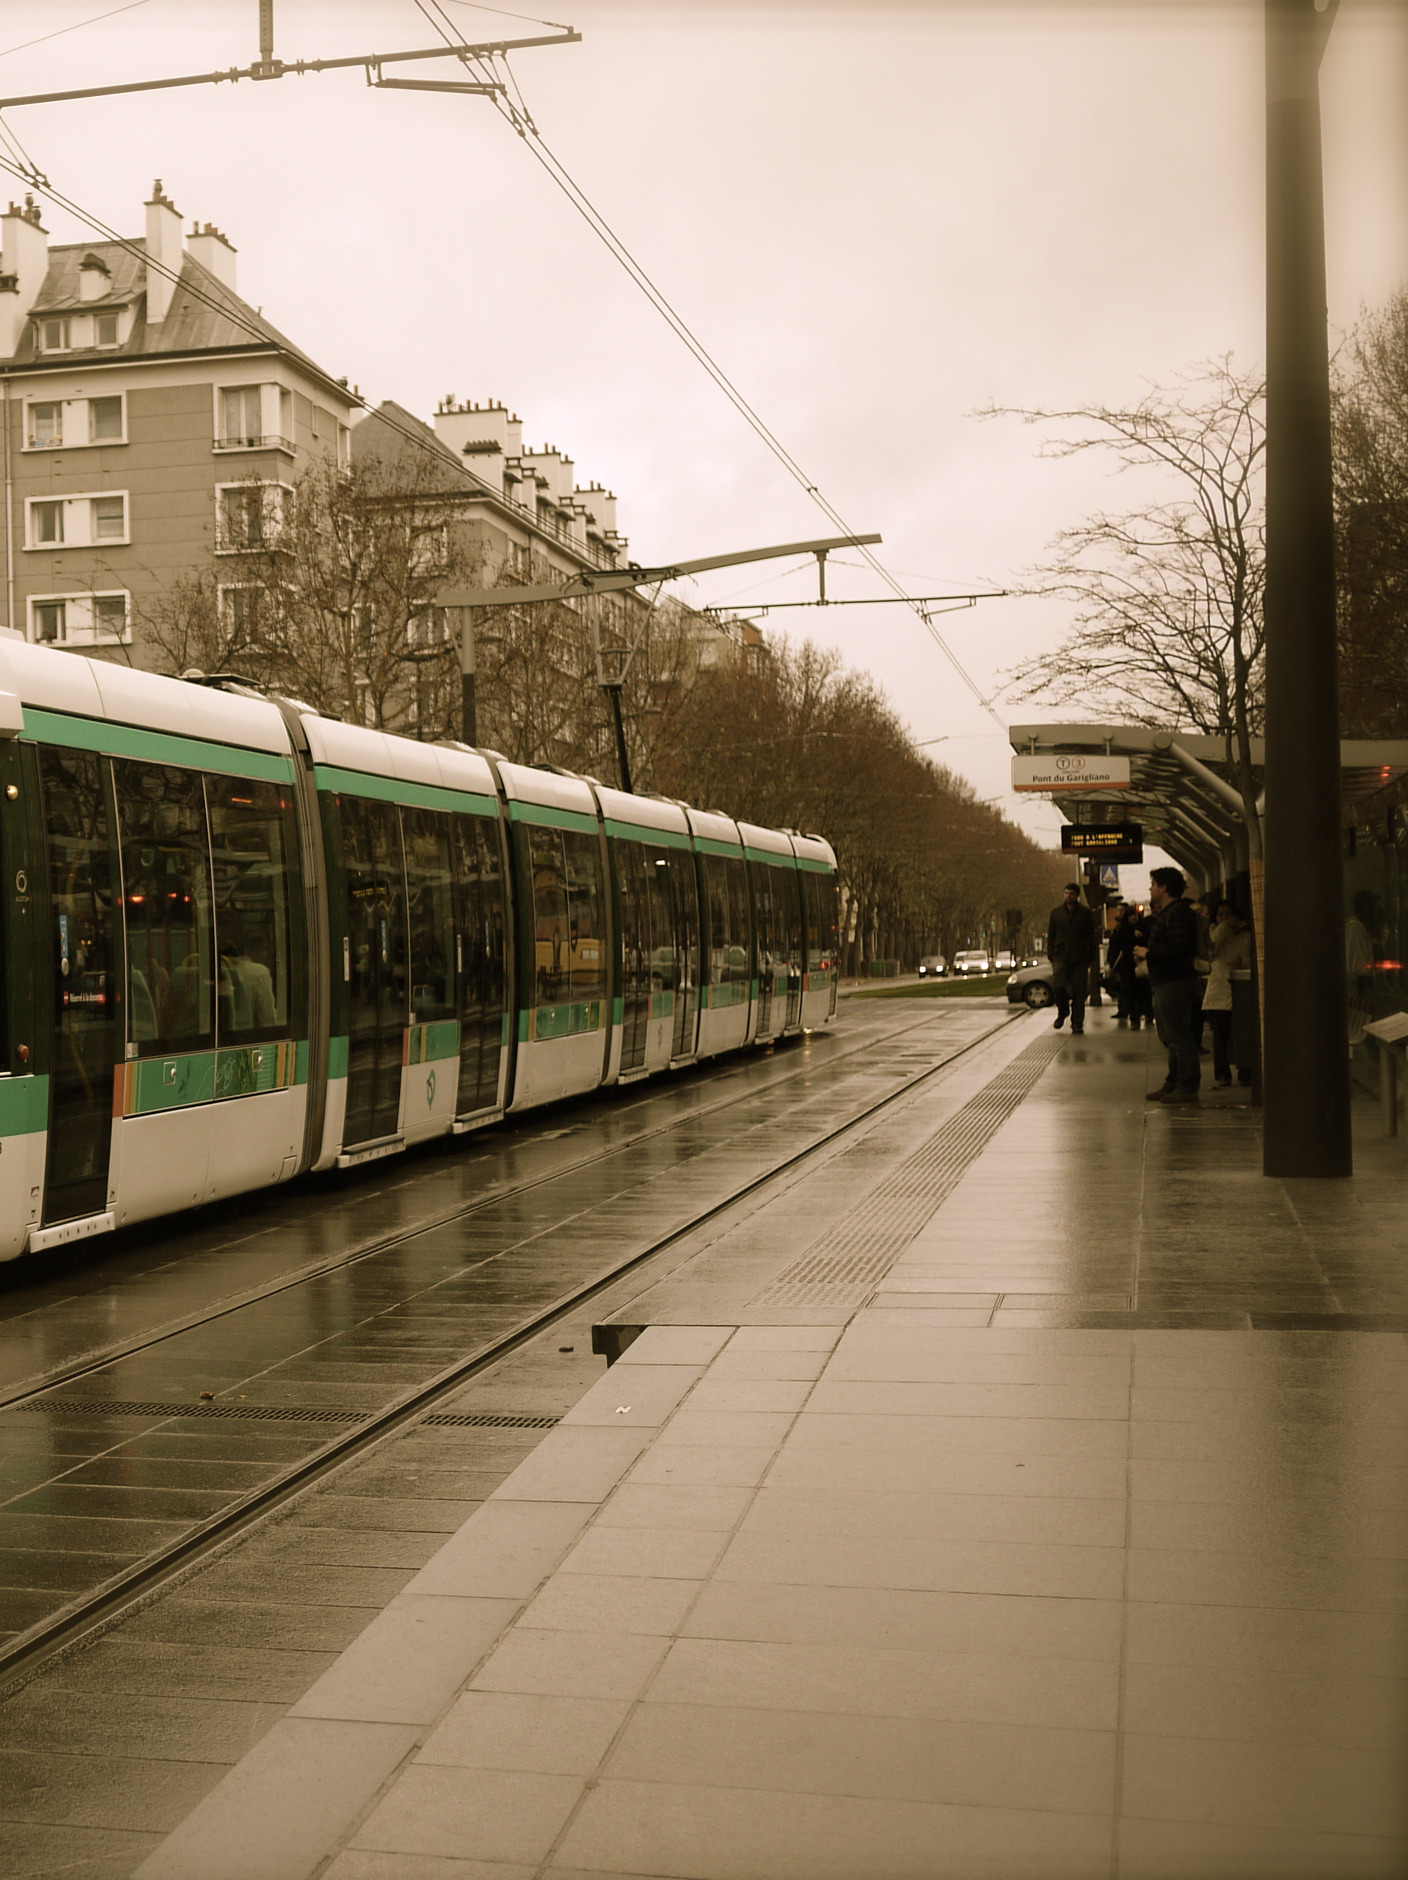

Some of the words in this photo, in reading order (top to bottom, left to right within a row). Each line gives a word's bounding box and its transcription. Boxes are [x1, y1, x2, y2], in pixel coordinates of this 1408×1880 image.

[1032, 774, 1052, 783] Pont
[1054, 774, 1065, 782] du
[1066, 773, 1110, 783] Garigliano
